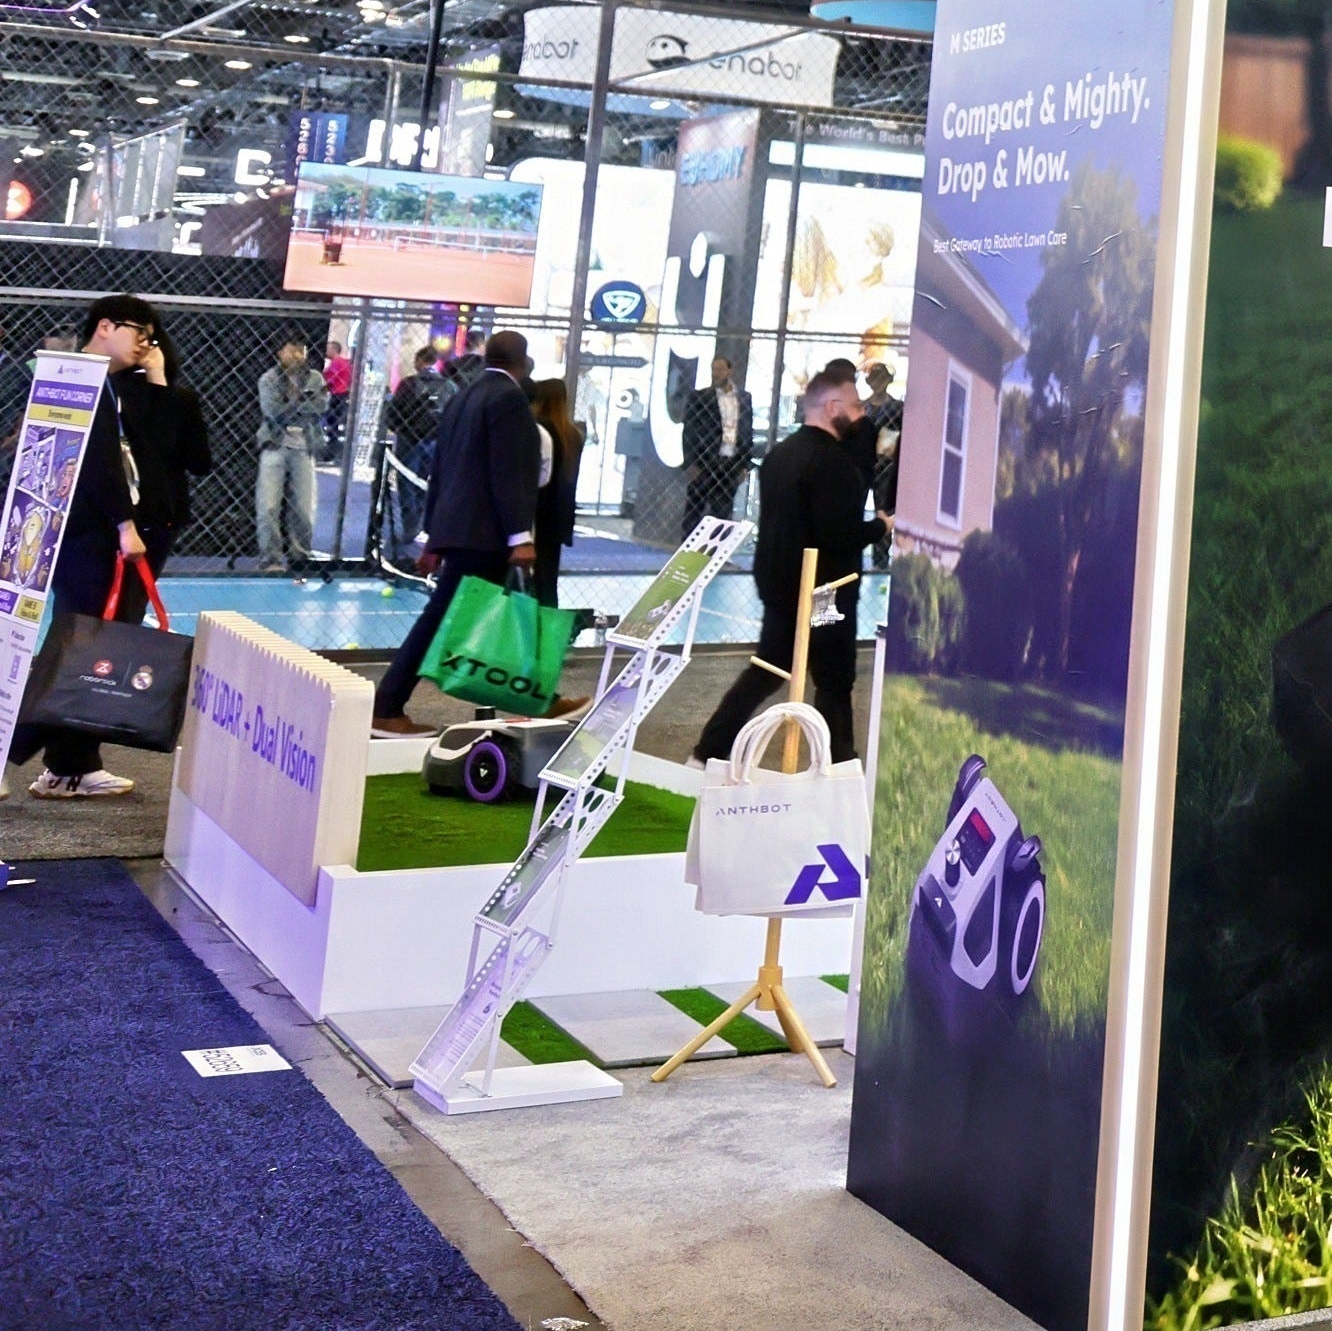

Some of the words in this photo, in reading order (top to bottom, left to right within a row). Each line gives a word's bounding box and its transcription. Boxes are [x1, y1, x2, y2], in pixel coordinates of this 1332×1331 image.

[950, 32, 962, 55] M
[962, 21, 1006, 53] SERIES
[942, 89, 1035, 145] Compact
[1039, 83, 1056, 126] &
[1064, 70, 1151, 130] Mighty.
[937, 157, 987, 203] Drop
[992, 148, 1009, 189] &
[1015, 145, 1070, 187] Mow.
[933, 238, 948, 254] Best
[950, 236, 982, 254] Gateway
[983, 235, 992, 250] to
[993, 232, 1023, 249] Robotic
[1024, 232, 1046, 248] Lawn
[1047, 231, 1067, 246] Care
[252, 704, 280, 766] Dual
[280, 721, 316, 793] Vision
[715, 803, 792, 817] ANTHBOT
